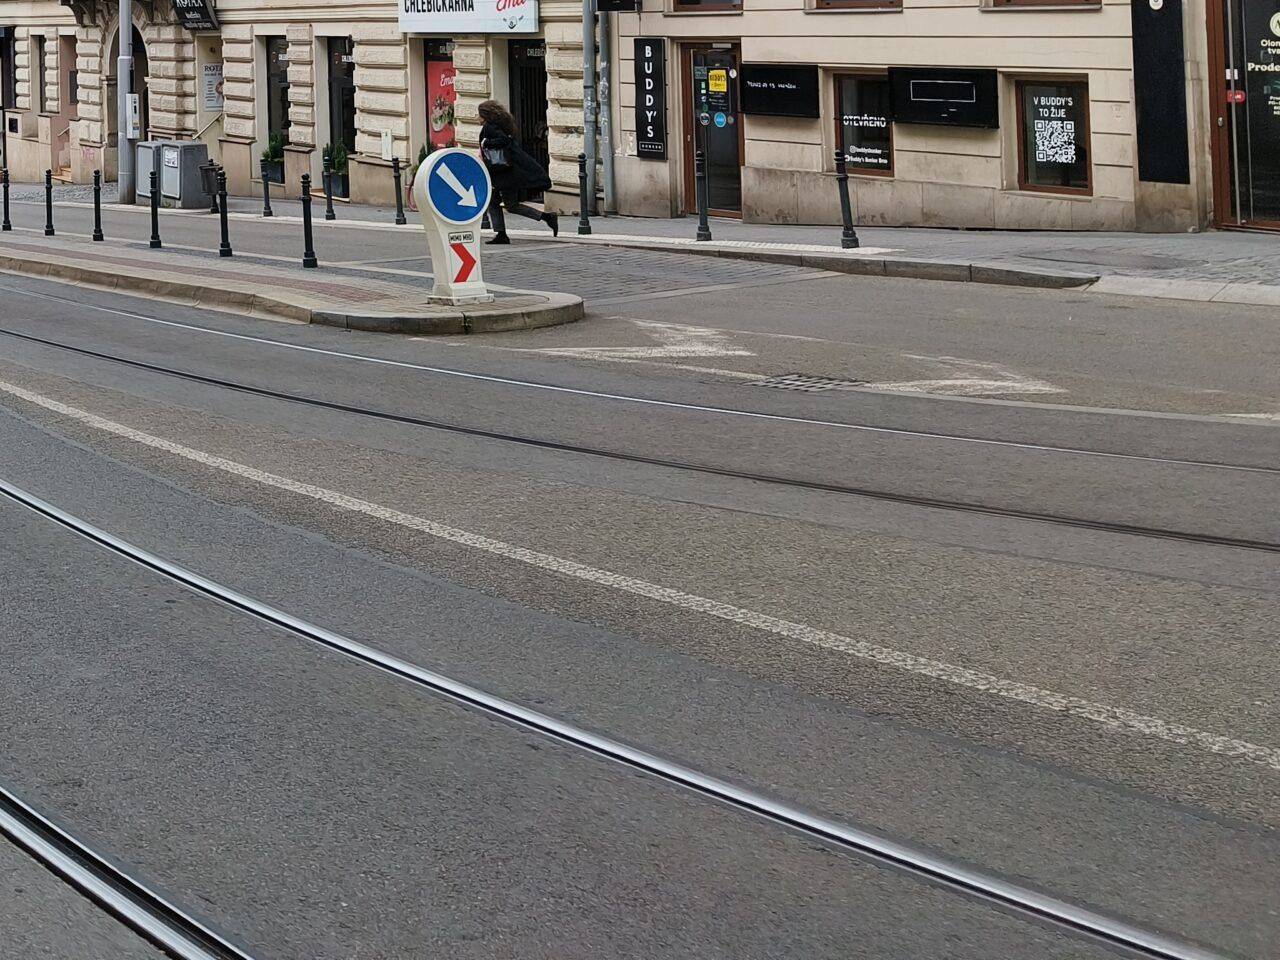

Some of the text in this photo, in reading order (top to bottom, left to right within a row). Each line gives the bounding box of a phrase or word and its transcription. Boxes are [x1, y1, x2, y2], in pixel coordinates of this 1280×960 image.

[644, 45, 657, 138] BUDDY'S
[1033, 96, 1073, 106] V BUDDY'S
[1039, 107, 1066, 117] TO ŽIJE
[843, 113, 887, 127] OTEVŘENO
